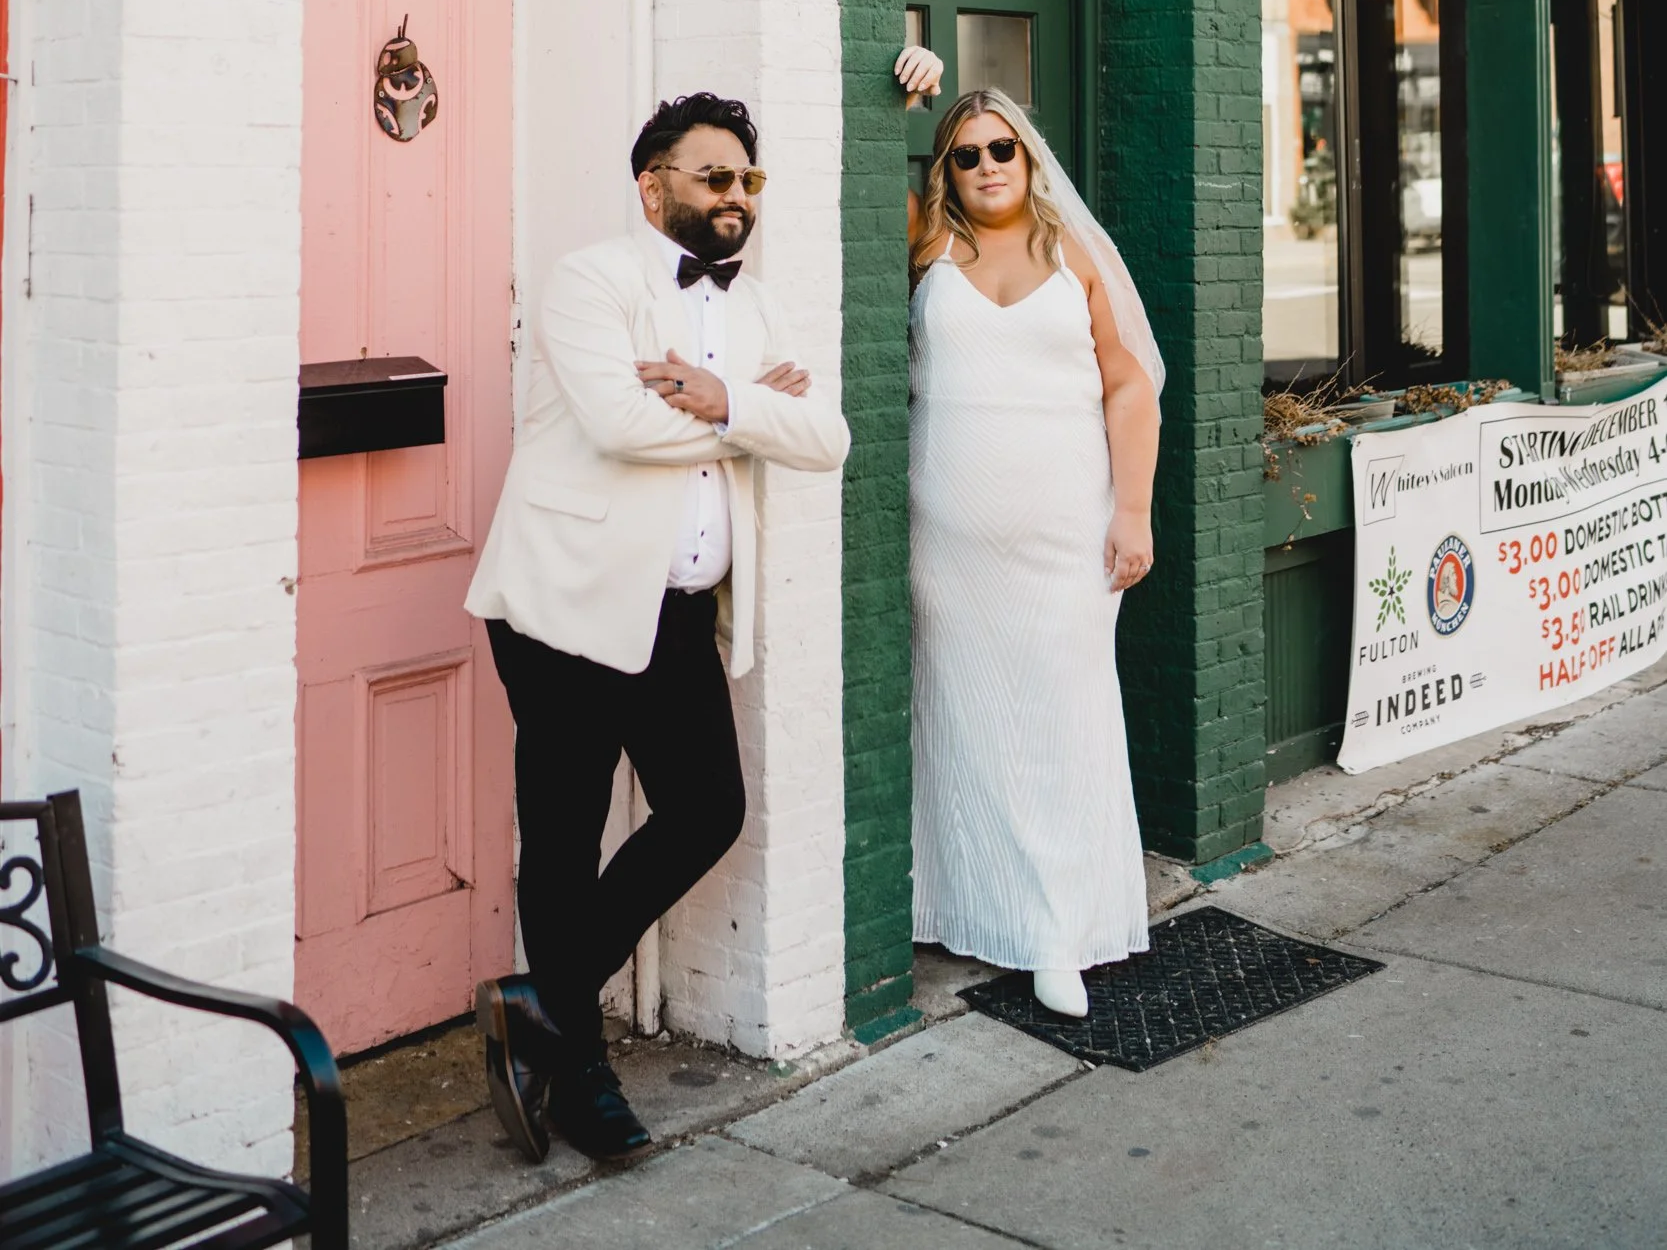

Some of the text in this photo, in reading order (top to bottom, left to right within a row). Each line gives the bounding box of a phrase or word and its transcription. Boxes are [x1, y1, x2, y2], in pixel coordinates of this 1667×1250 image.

[1499, 398, 1658, 469] STARTING DECEMBER
[1648, 434, 1667, 464] 4-
[1429, 537, 1472, 579] PAULANER
[1498, 531, 1558, 575] $3.00
[1564, 506, 1629, 556] DOMESTIC
[1528, 567, 1581, 611] $3.00
[1583, 539, 1655, 590] DOMESTIC
[1588, 593, 1625, 629] RAIL
[1359, 629, 1419, 667] FULTON
[1539, 650, 1586, 691] HALF
[1588, 636, 1616, 671] OFF
[1618, 625, 1644, 659] ALL
[1401, 664, 1437, 684] BREWING
[1376, 673, 1463, 727] INDEED
[1400, 714, 1441, 735] COMPANY
